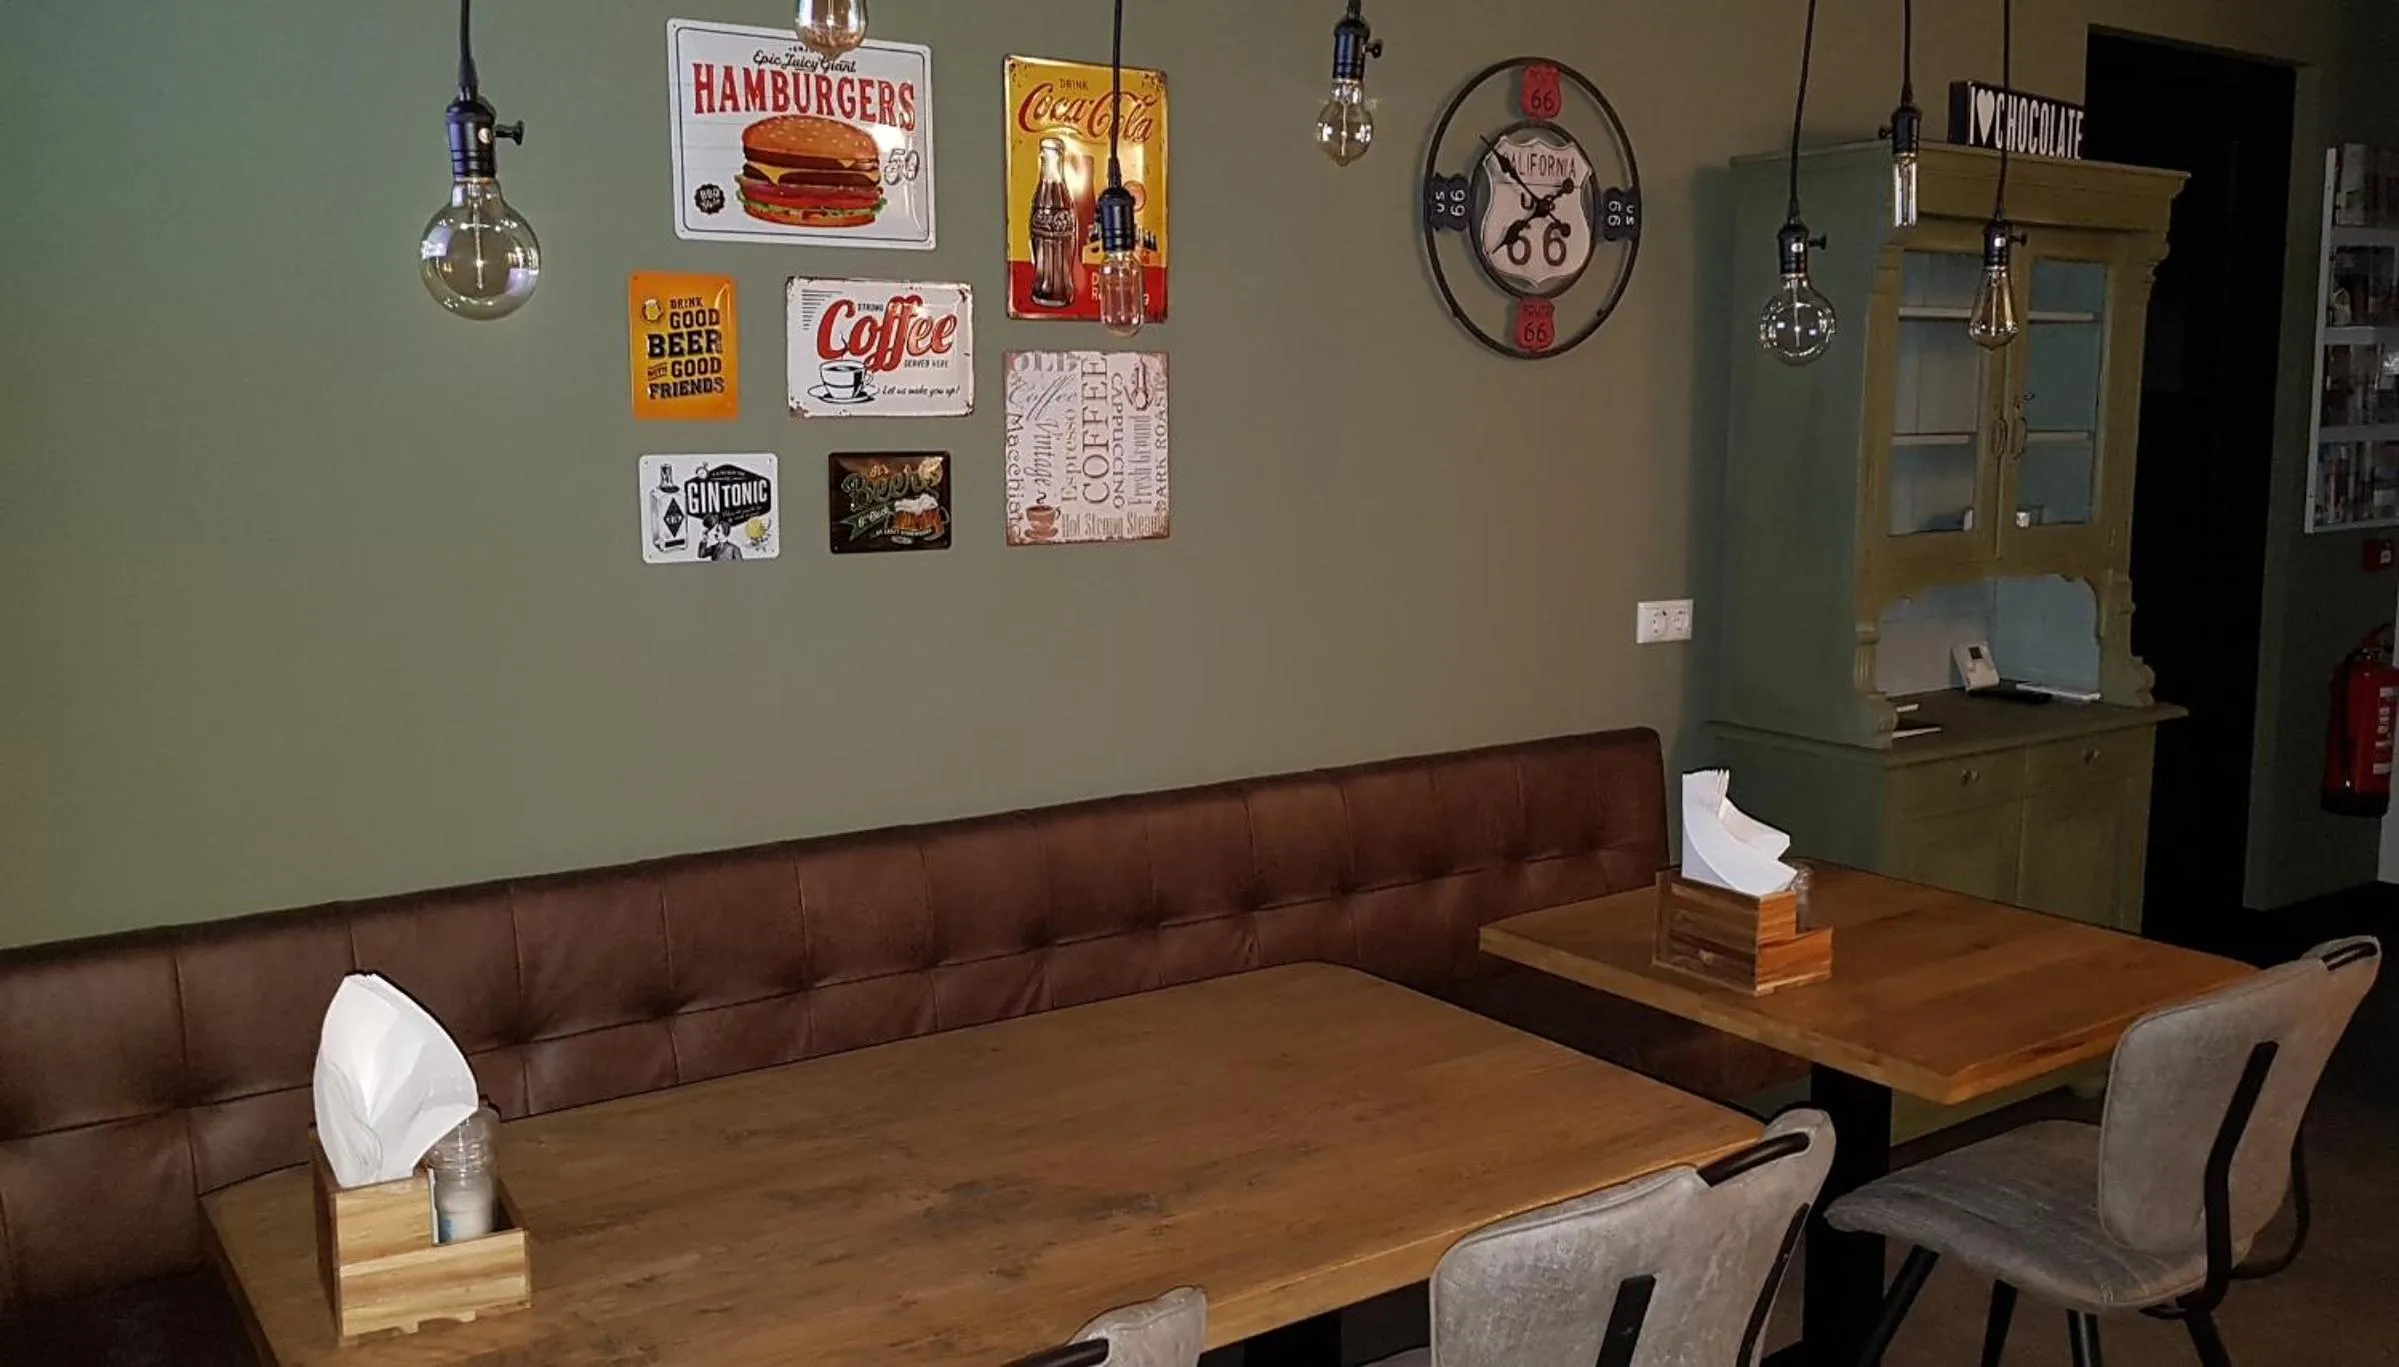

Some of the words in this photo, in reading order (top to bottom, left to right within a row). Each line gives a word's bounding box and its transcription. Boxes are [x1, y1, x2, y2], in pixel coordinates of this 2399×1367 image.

[752, 49, 781, 66] Epic
[781, 53, 819, 73] Juicy
[820, 54, 857, 73] Giant
[692, 63, 918, 132] HAMBURGERS
[1060, 79, 1089, 91] DRINK
[1531, 88, 1555, 112] 66
[1968, 86, 1976, 145] I
[1995, 92, 2085, 160] CHOCOLATE
[1503, 150, 1577, 178] ALIFORNIA
[1434, 191, 1446, 213] US
[1450, 189, 1466, 217] 66
[1608, 200, 1621, 226] 66
[1625, 204, 1635, 226] US
[1507, 221, 1567, 267] 66
[670, 297, 703, 309] DRINK
[857, 303, 884, 313] STRONG
[670, 308, 720, 330] GOOD
[1524, 321, 1548, 342] 66
[647, 329, 723, 358] BEER
[817, 295, 958, 373] Coffee
[671, 357, 722, 379] GOOD
[649, 377, 726, 400] FRIENDS
[1081, 356, 1110, 504] COFFEE
[1111, 372, 1126, 510] CAPPUCCINO
[1024, 418, 1064, 487] Vintage
[1061, 408, 1081, 502] Espresso
[687, 481, 720, 514] GIN
[722, 480, 768, 508] TONIC
